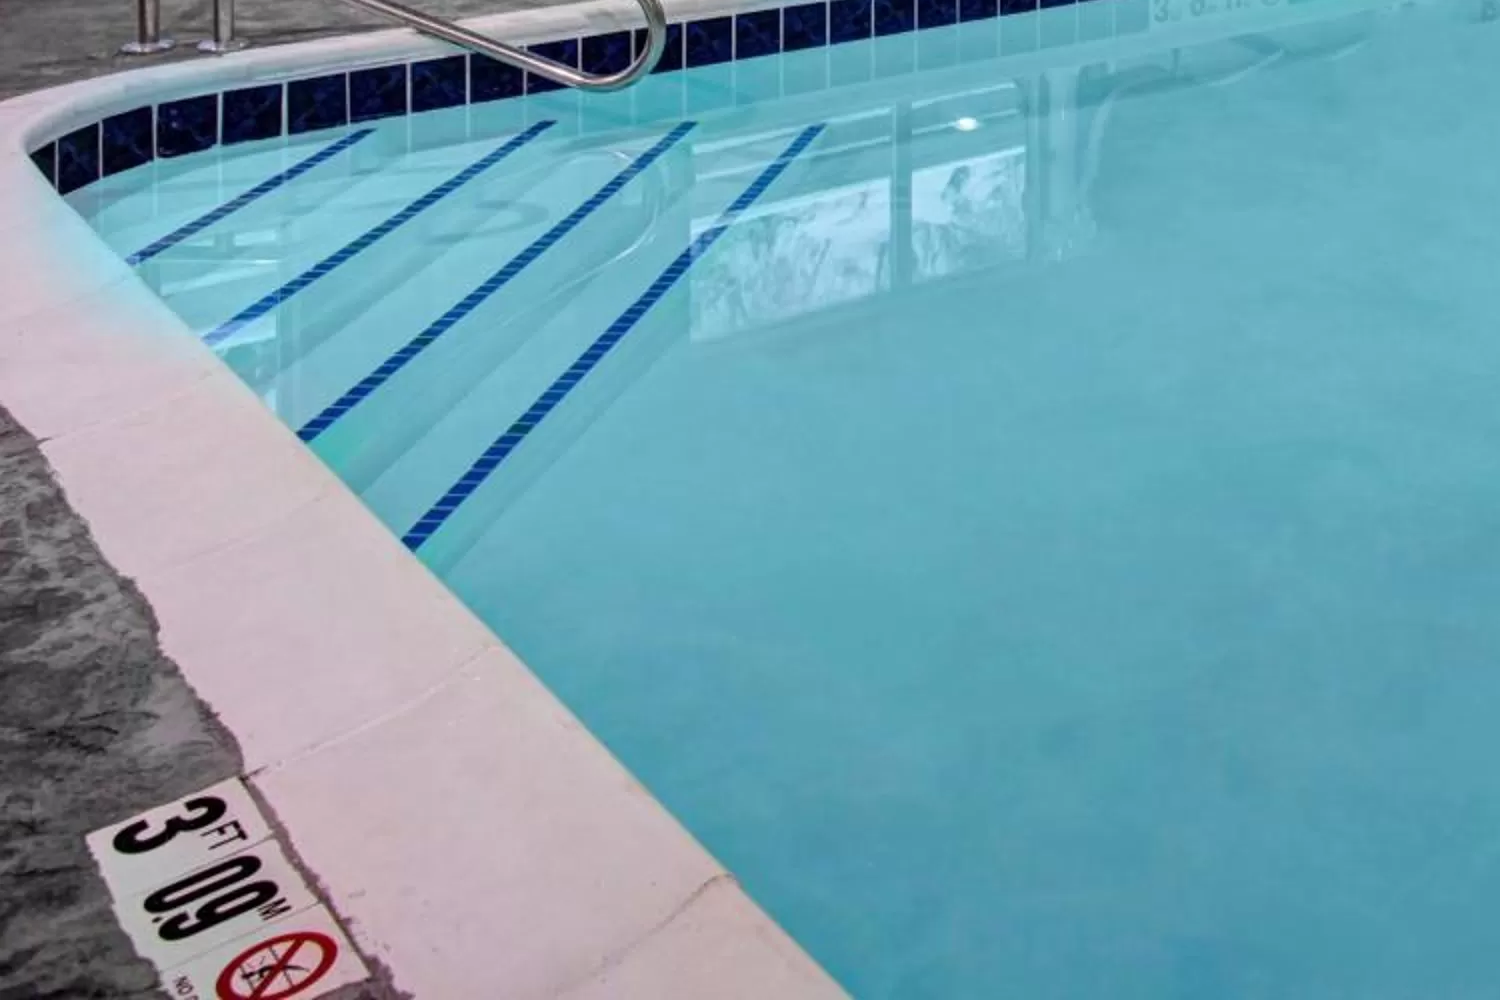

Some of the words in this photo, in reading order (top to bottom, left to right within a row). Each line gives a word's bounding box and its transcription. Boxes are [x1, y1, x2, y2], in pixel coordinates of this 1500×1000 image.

[113, 796, 227, 854] 3
[201, 820, 248, 850] FT
[255, 897, 292, 921] M
